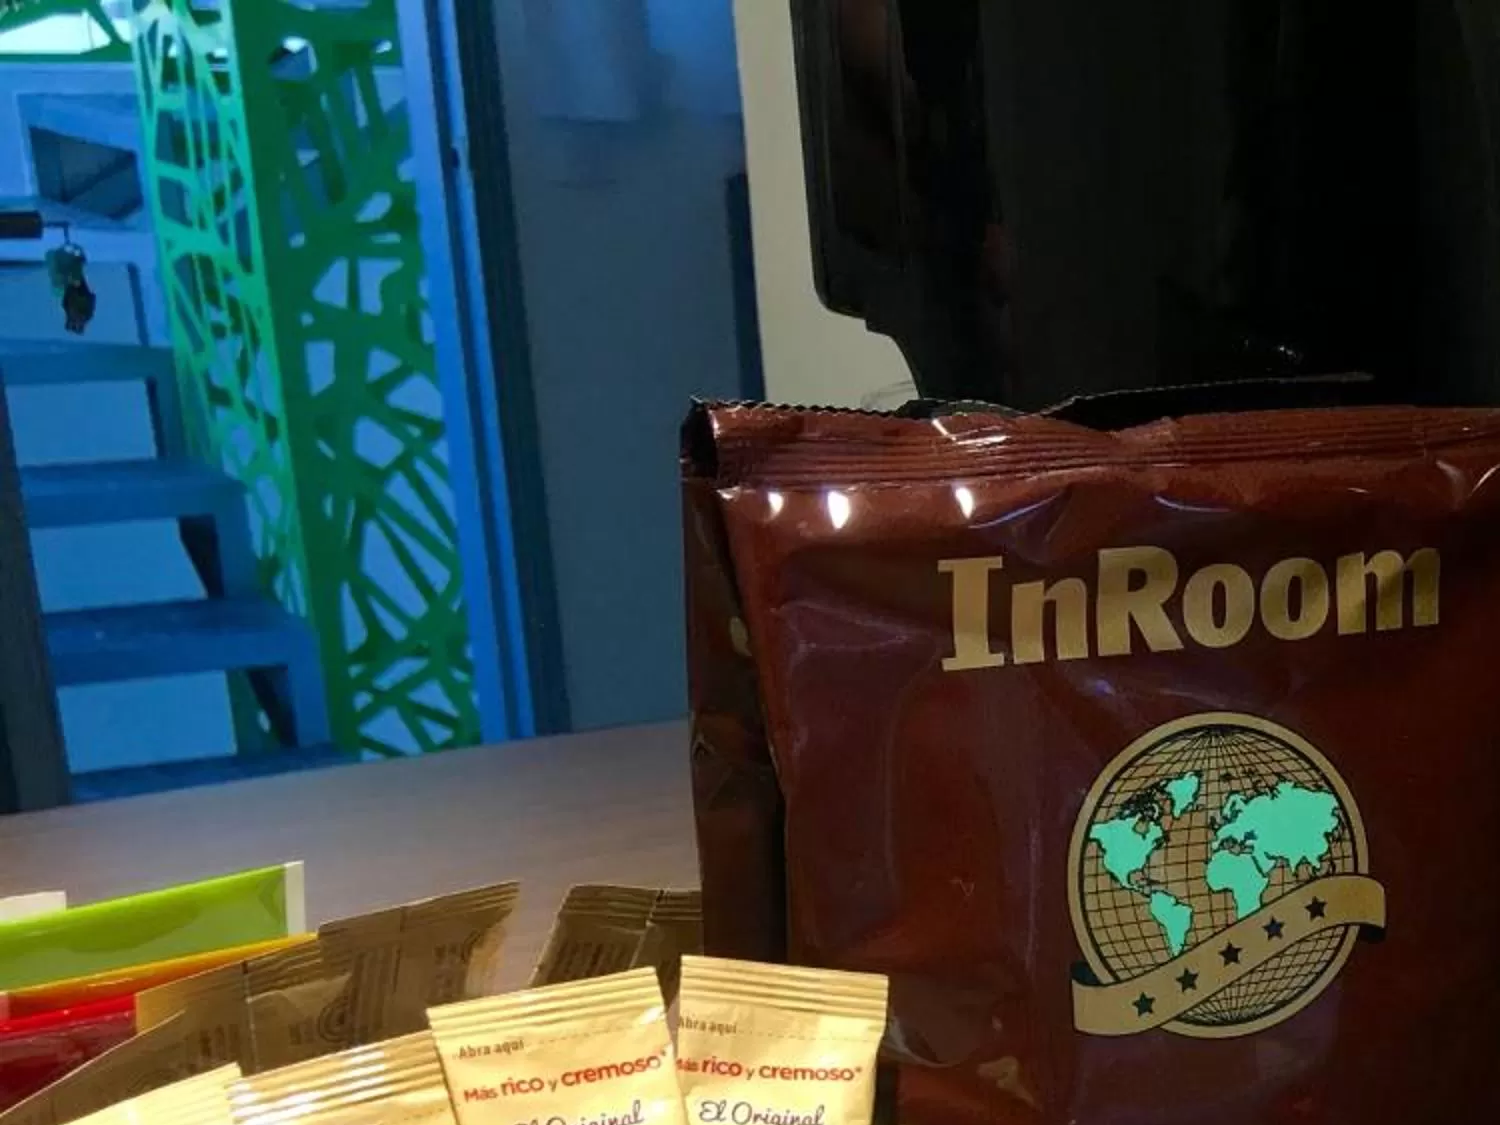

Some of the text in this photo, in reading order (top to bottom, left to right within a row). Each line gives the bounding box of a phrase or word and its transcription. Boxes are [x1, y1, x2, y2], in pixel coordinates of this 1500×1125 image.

[938, 544, 1441, 673] InRoom
[675, 1056, 699, 1073] ás
[701, 1055, 742, 1078] rico
[745, 1067, 756, 1082] y
[463, 1085, 498, 1104] Más
[500, 1075, 545, 1097] rico
[548, 1079, 559, 1093] y
[698, 1099, 728, 1123] El
